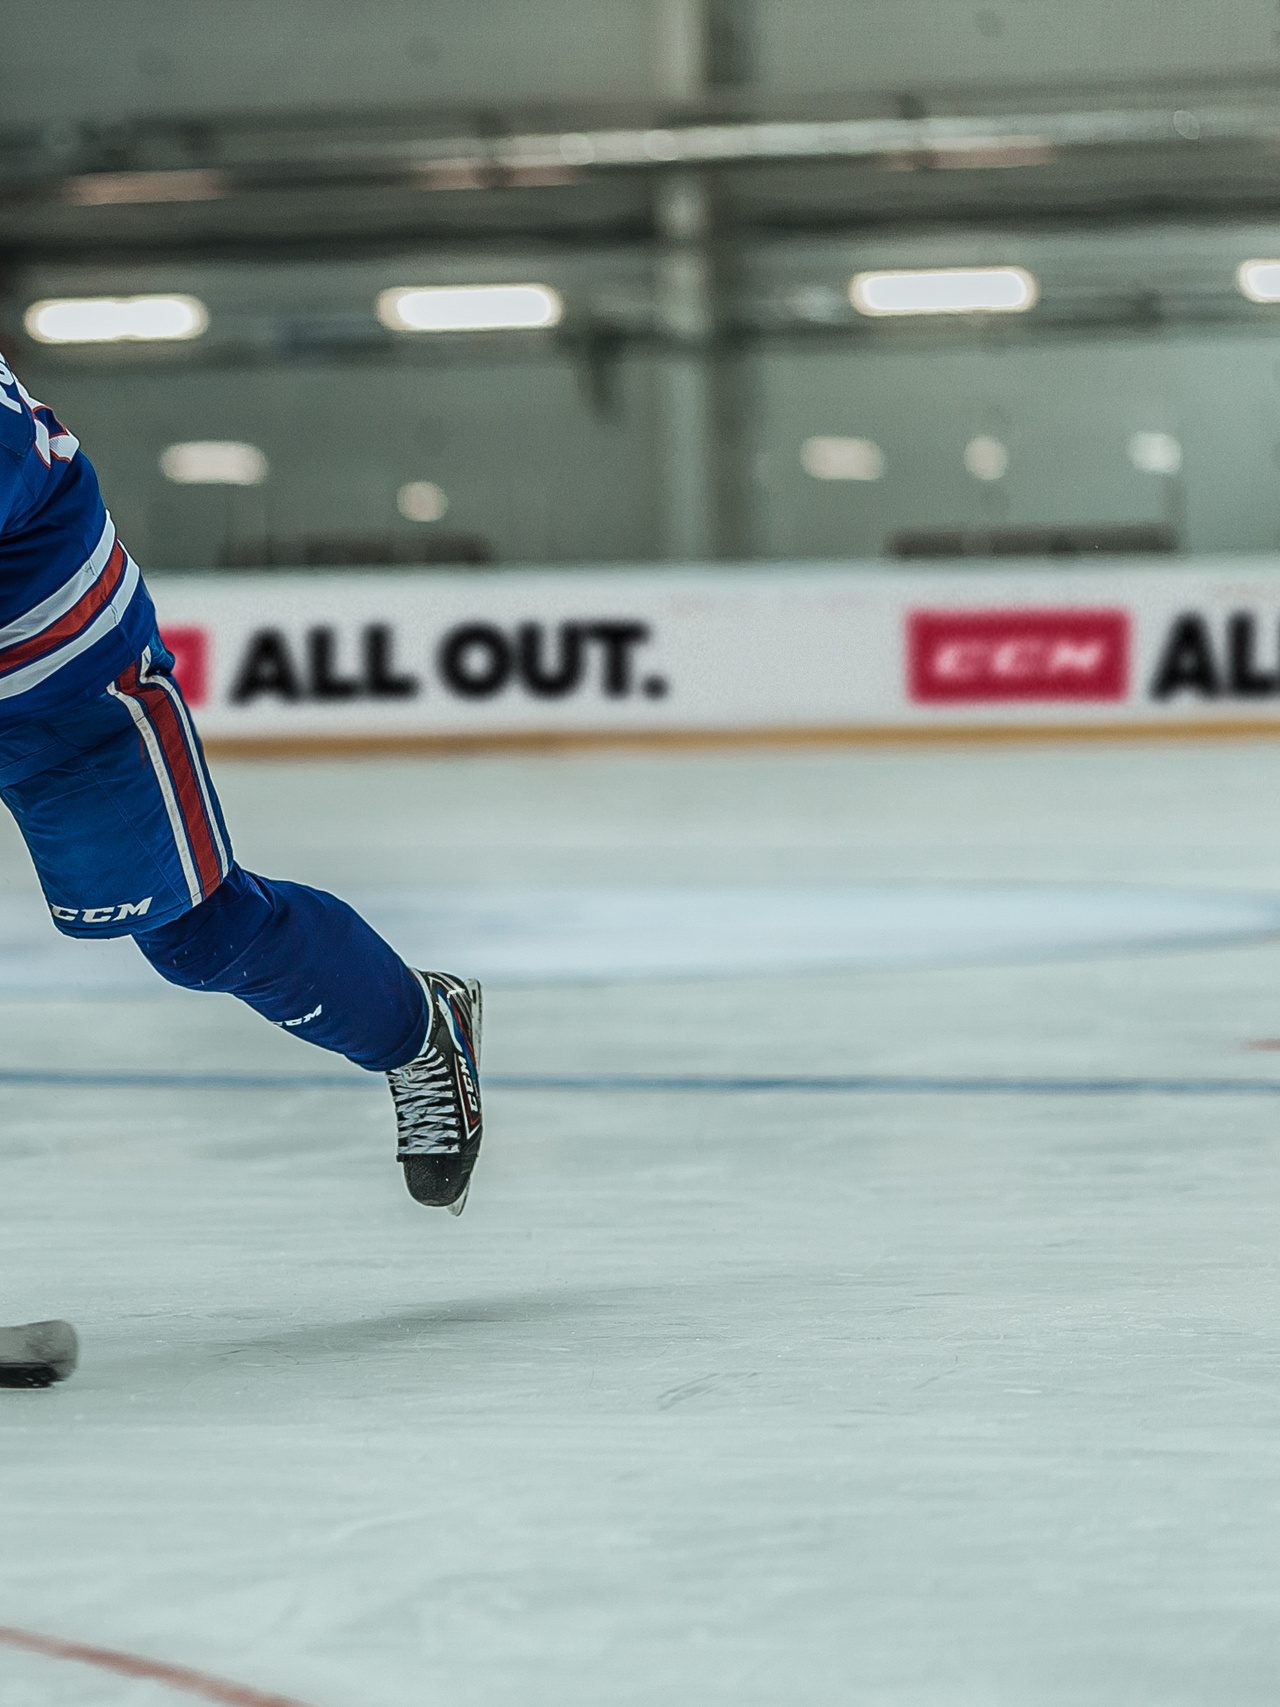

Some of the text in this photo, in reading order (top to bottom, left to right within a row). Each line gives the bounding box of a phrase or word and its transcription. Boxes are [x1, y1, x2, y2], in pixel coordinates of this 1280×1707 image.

[227, 619, 669, 708] ALL OUT.
[1150, 609, 1280, 706] AL
[49, 896, 153, 923] CCM
